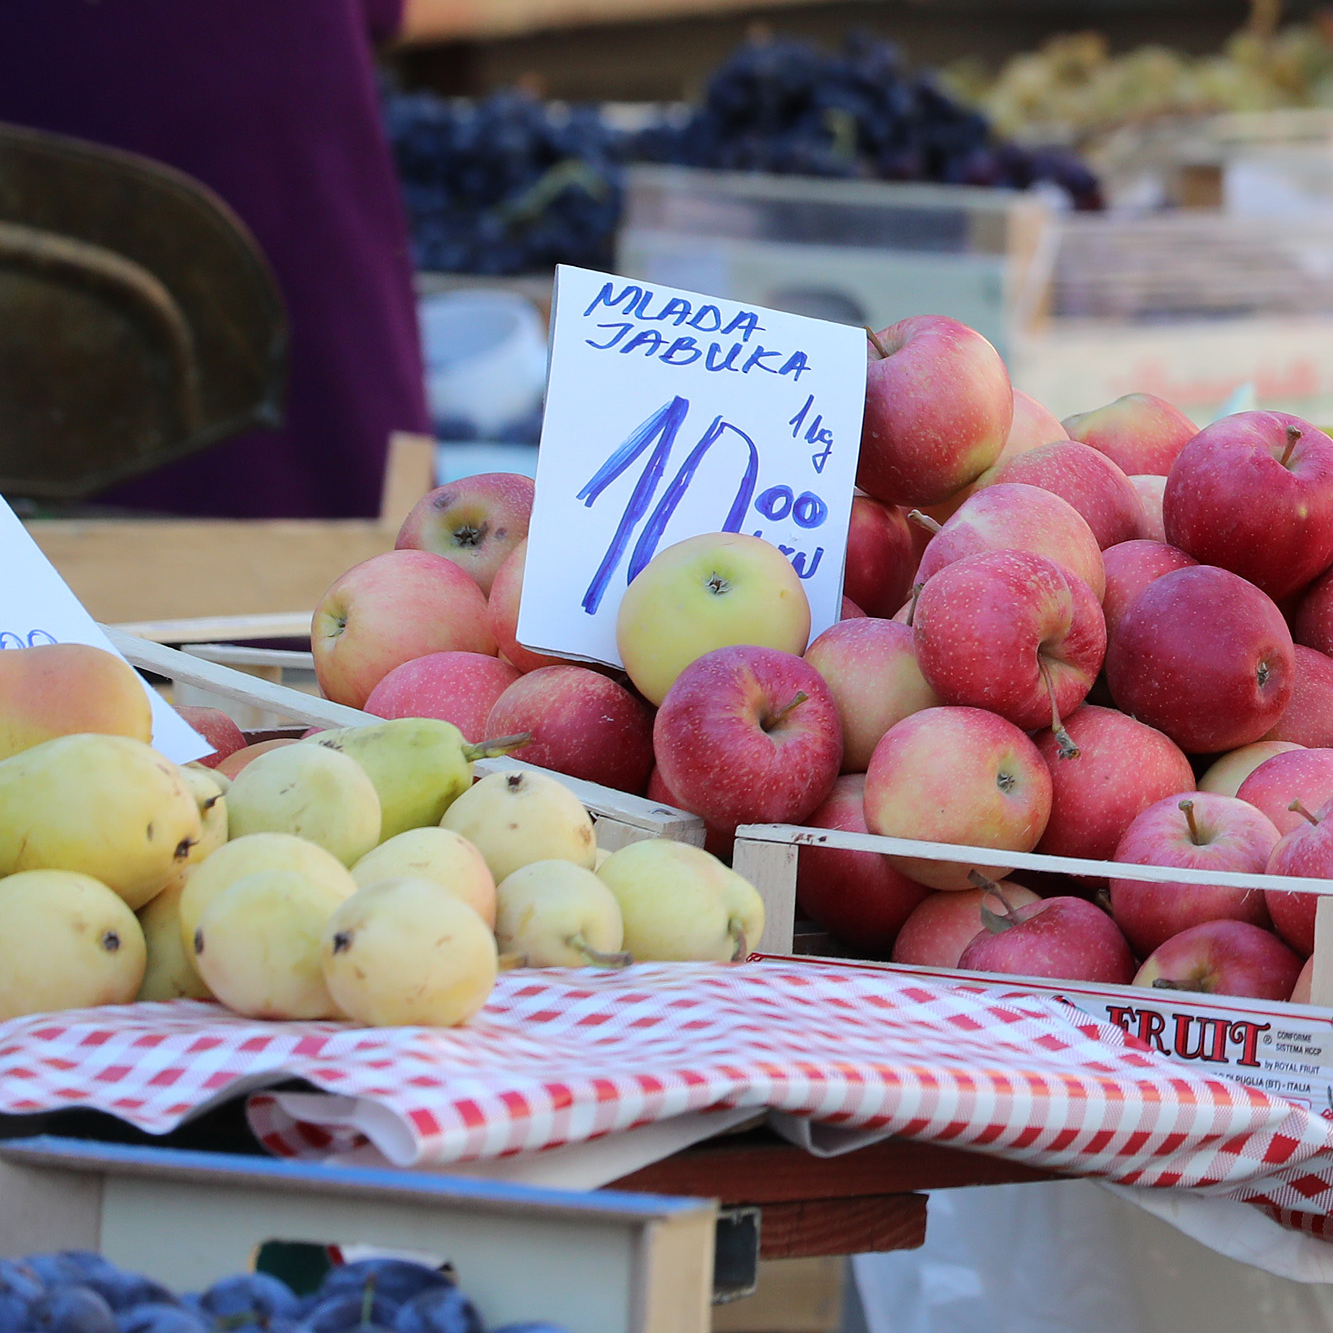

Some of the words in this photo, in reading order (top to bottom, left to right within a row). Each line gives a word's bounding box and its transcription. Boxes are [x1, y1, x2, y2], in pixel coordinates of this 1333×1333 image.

[583, 282, 766, 342] MLADA
[585, 323, 811, 382] JABUKA
[1106, 1005, 1271, 1068] FRUIT
[1277, 1030, 1312, 1043] CONFORME
[1275, 1043, 1303, 1054] SISTEMA
[1264, 1060, 1273, 1072] by
[1274, 1061, 1298, 1073] ROYAL
[1299, 1064, 1320, 1075] FRUIT
[1287, 1082, 1311, 1093] ITALIA
